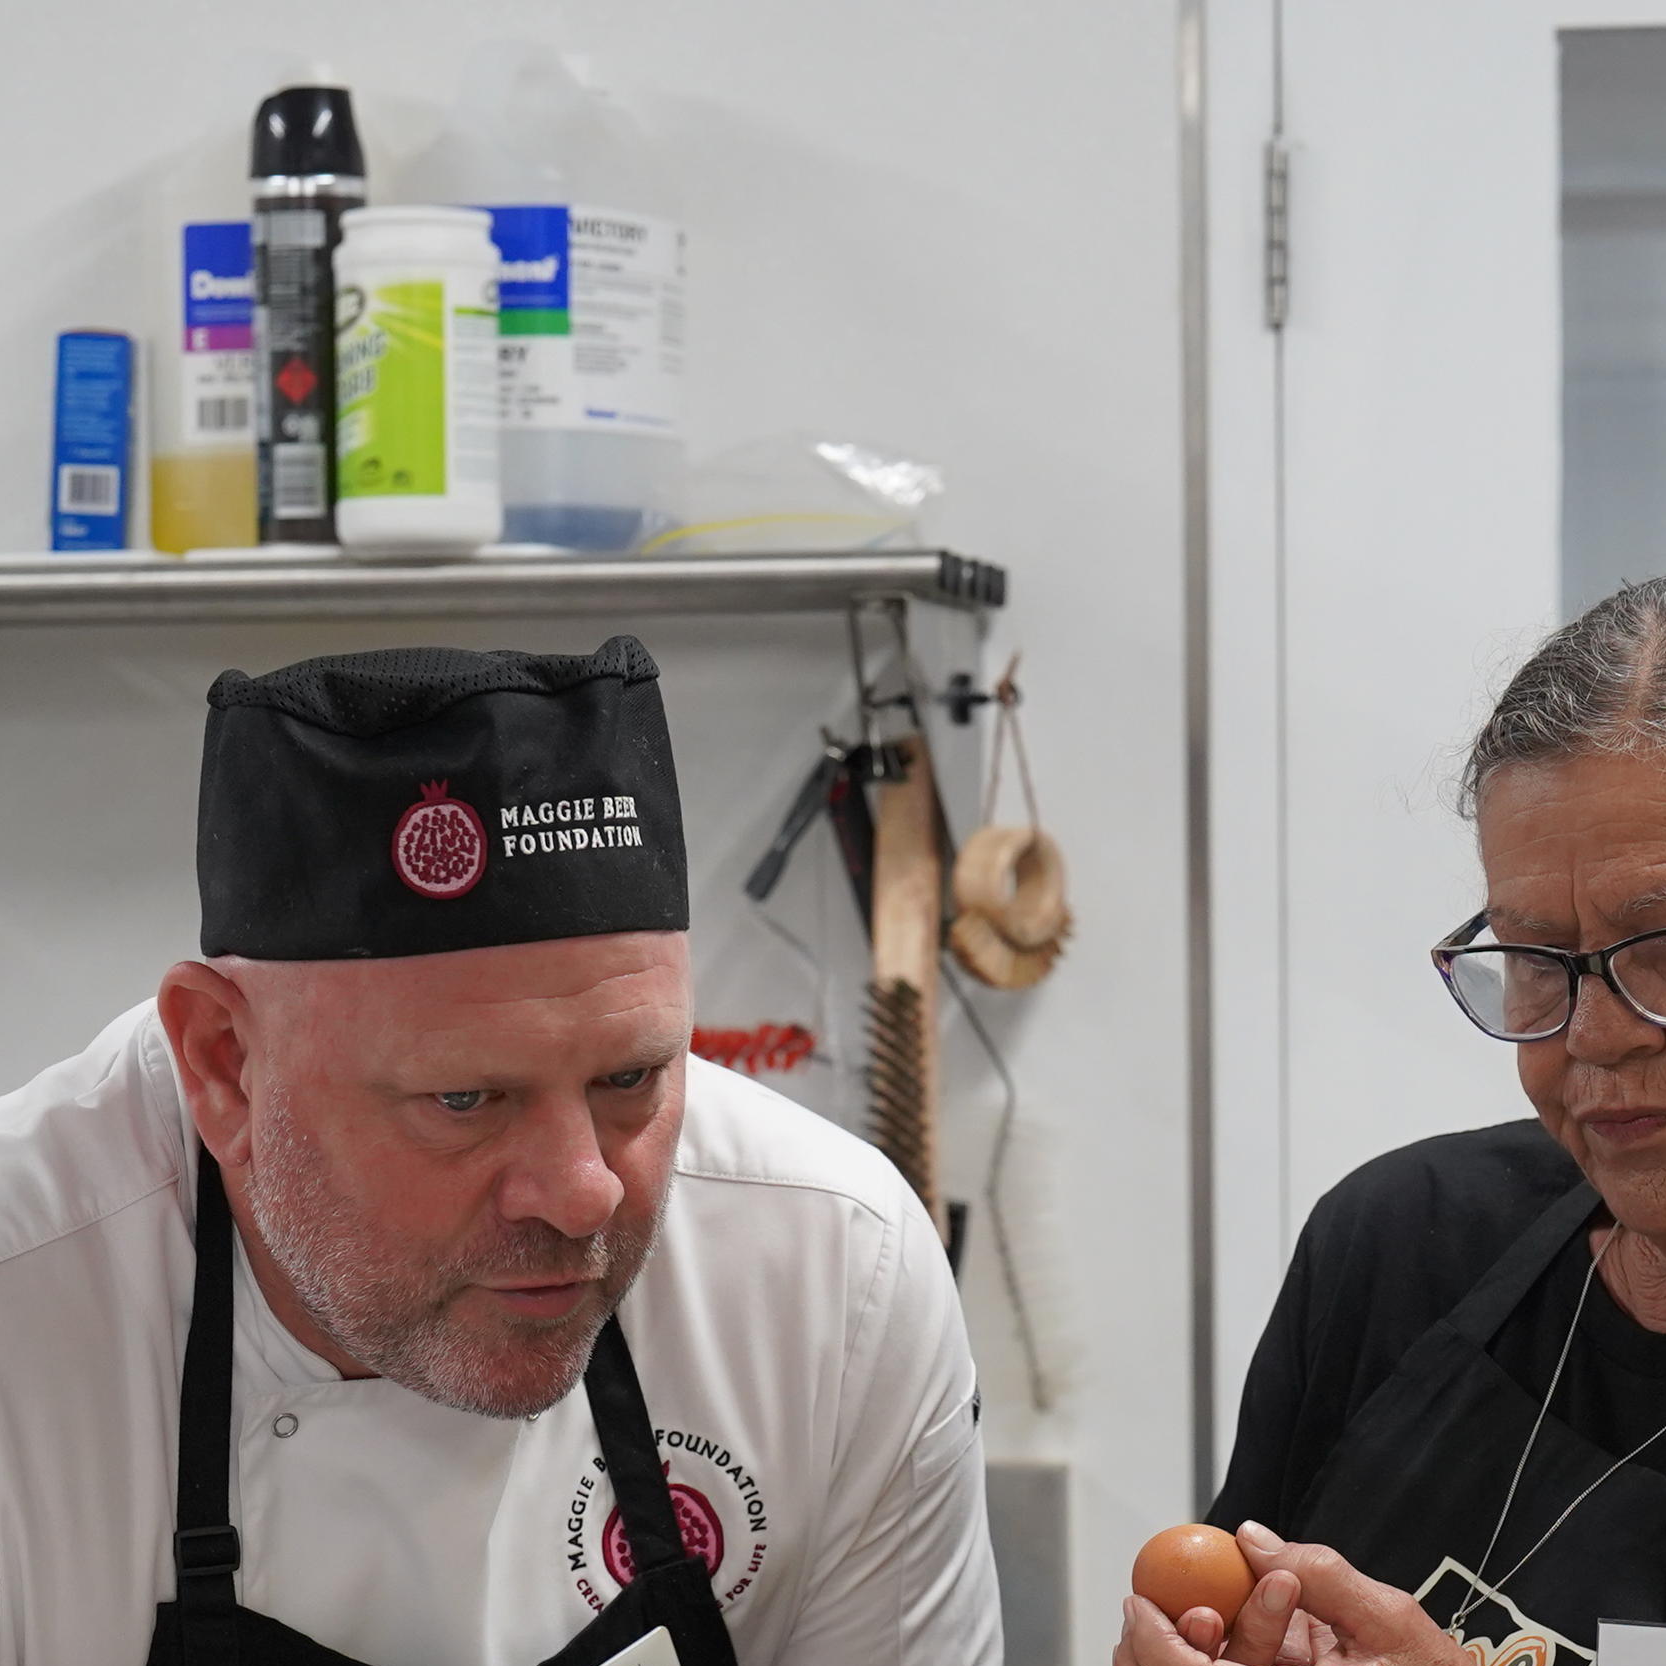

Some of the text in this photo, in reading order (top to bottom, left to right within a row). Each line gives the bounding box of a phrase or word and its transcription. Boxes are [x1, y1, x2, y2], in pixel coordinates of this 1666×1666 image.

[501, 796, 638, 829] MAGGIE BEER
[503, 825, 643, 858] FOUNDATION
[567, 1429, 767, 1572] MAGGIE FOUNDATION
[726, 1576, 753, 1602] FOR
[748, 1543, 767, 1573] LIFE
